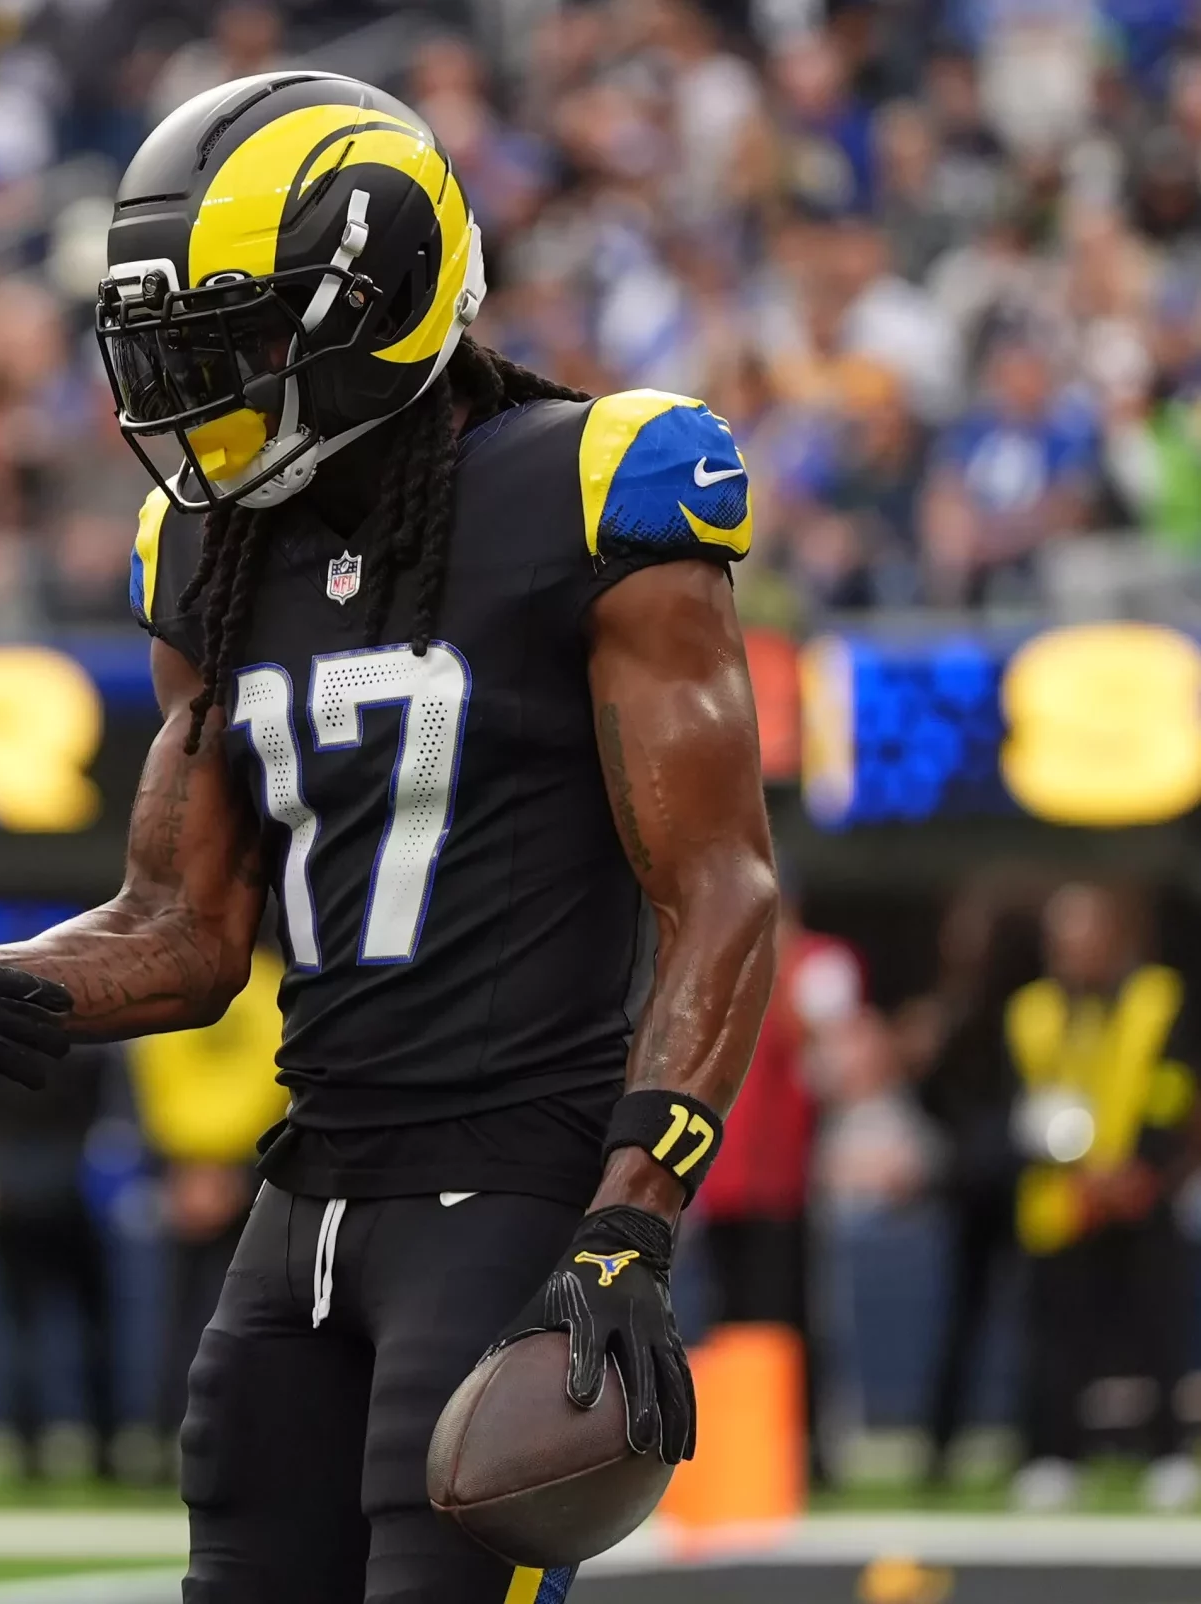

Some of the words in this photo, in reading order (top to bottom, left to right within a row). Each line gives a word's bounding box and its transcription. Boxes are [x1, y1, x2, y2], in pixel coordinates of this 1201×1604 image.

[333, 575, 354, 594] NFL
[230, 638, 473, 974] 17
[651, 1103, 715, 1178] 17
